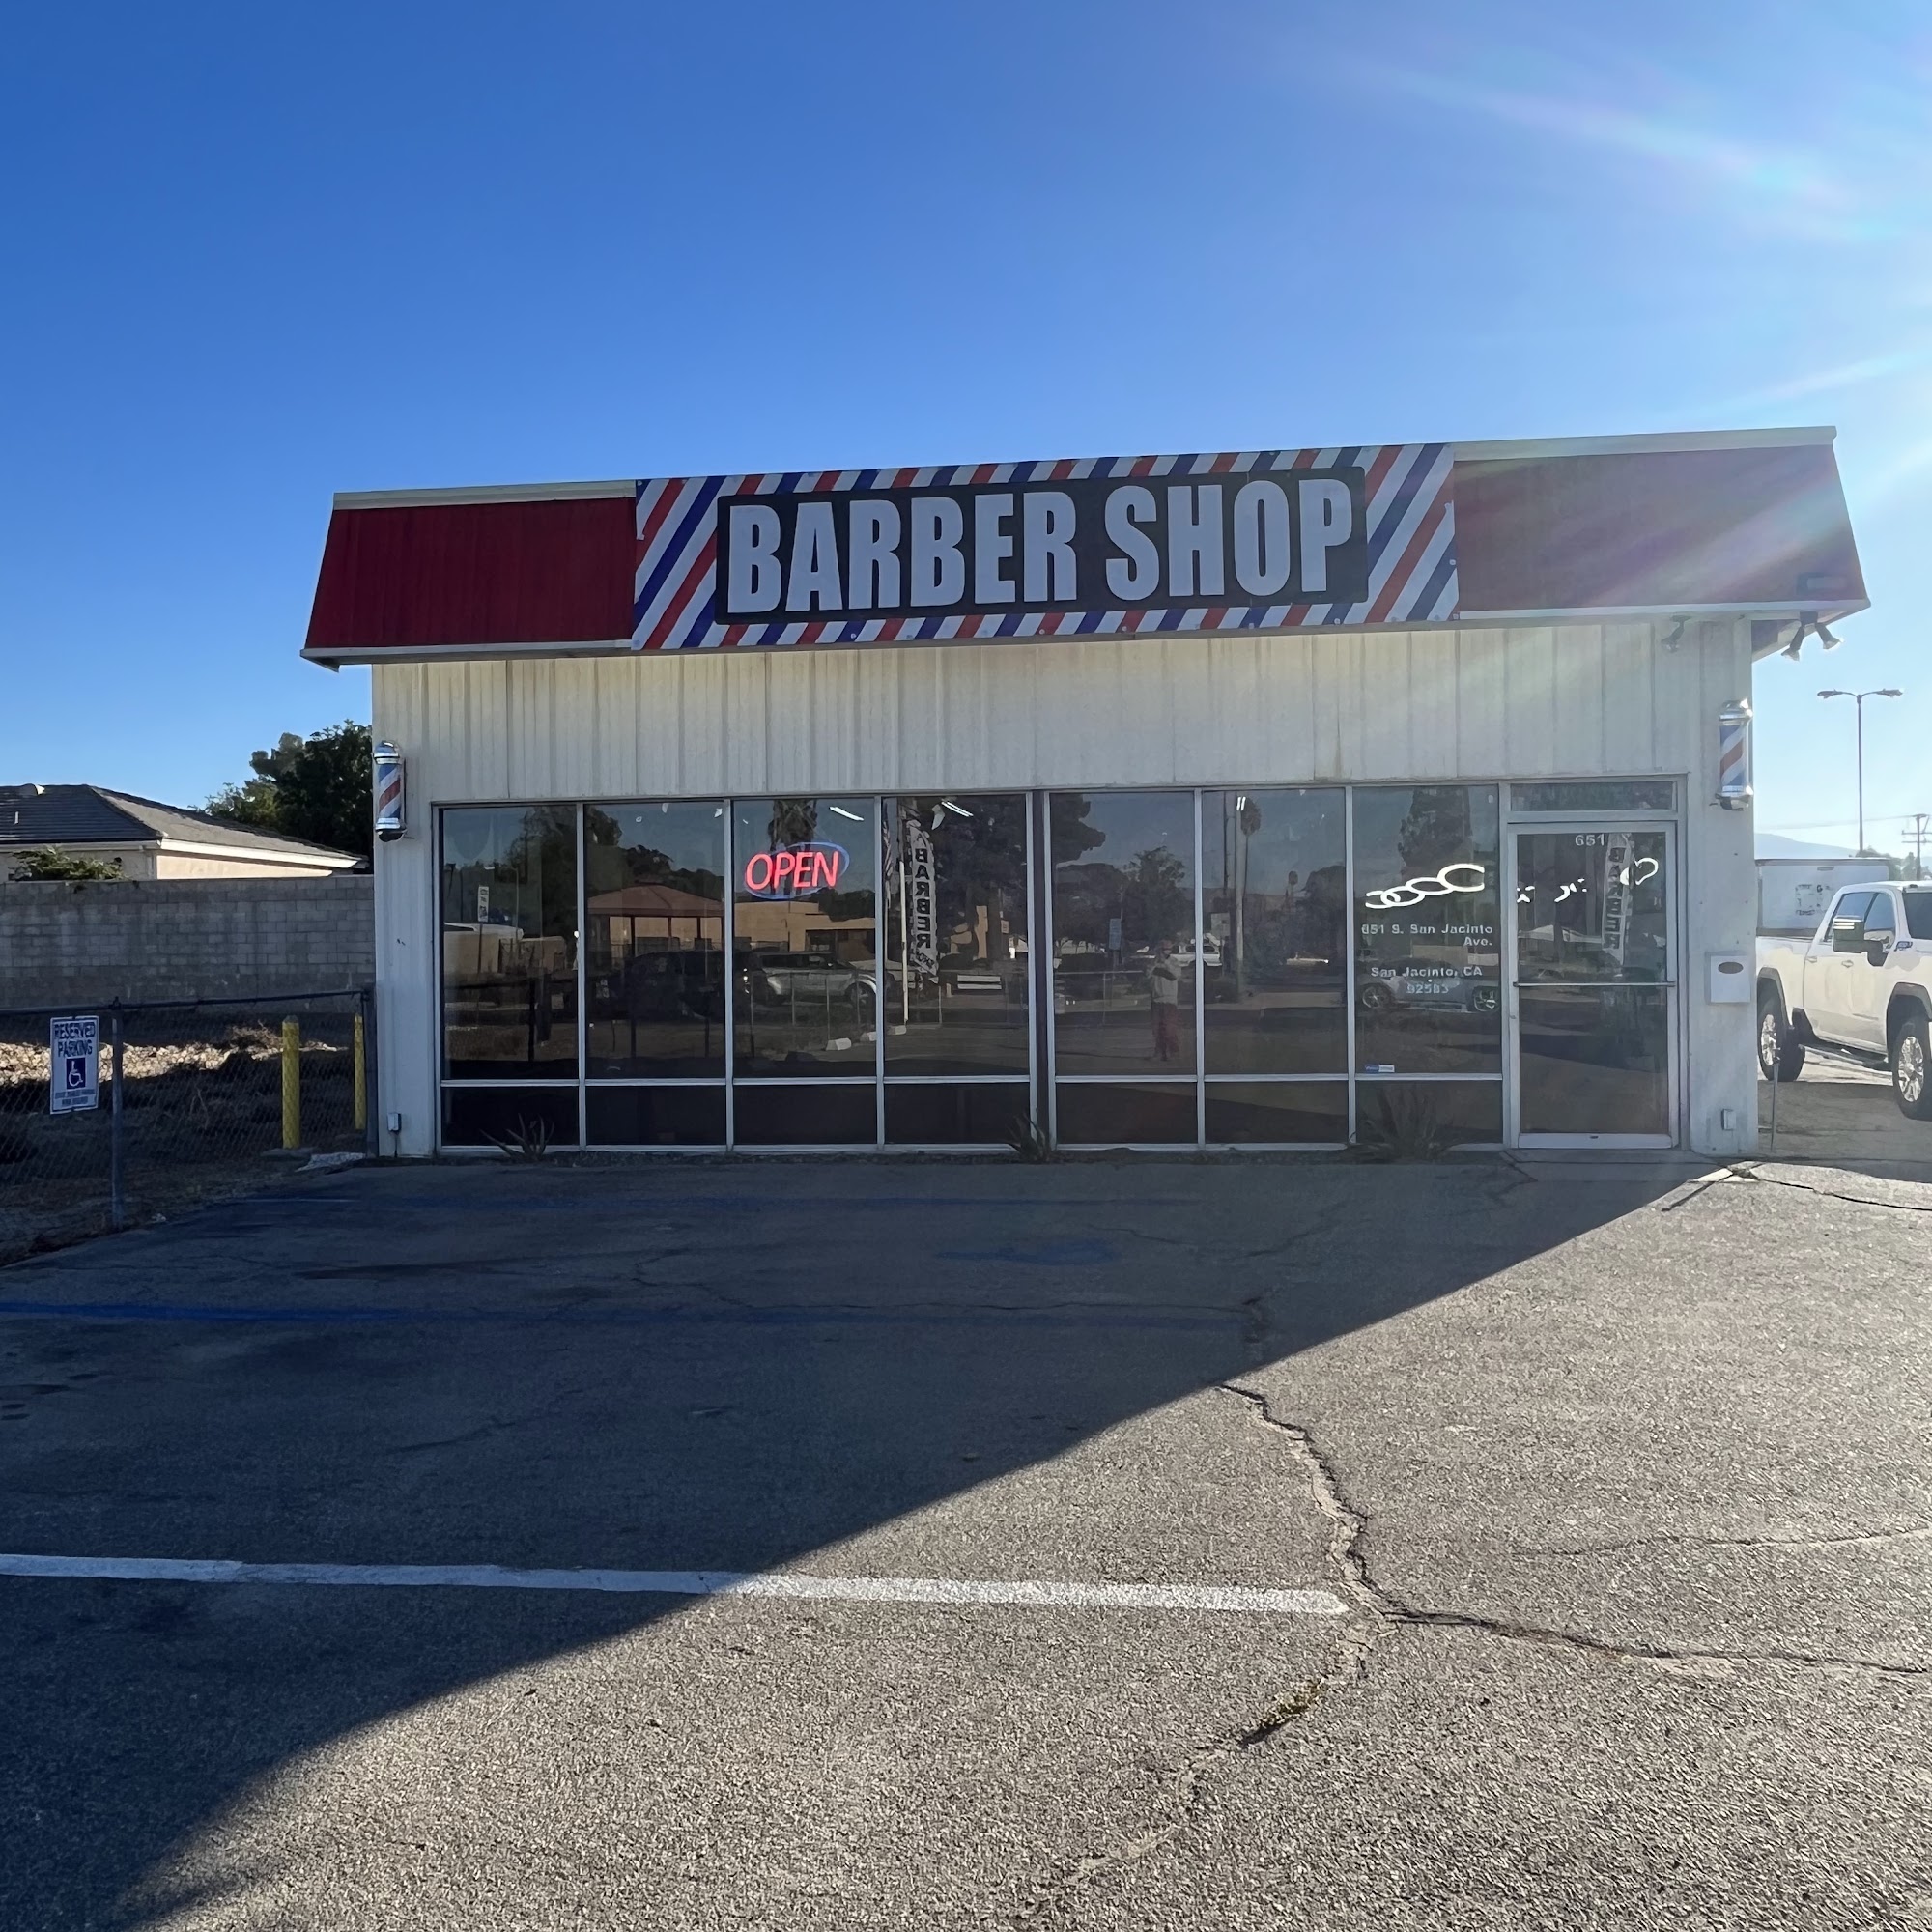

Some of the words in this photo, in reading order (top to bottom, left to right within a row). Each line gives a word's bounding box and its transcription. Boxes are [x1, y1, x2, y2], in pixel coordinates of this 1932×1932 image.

[727, 492, 1078, 614] BARBER
[1105, 478, 1352, 599] SHOP
[1576, 834, 1605, 846] 651
[746, 851, 839, 890] OPEN
[1361, 924, 1384, 934] 651
[1391, 924, 1404, 934] S.
[1410, 924, 1435, 934] San
[1441, 924, 1492, 934] Jacinto
[1371, 967, 1396, 977] San
[1463, 966, 1483, 976] CA
